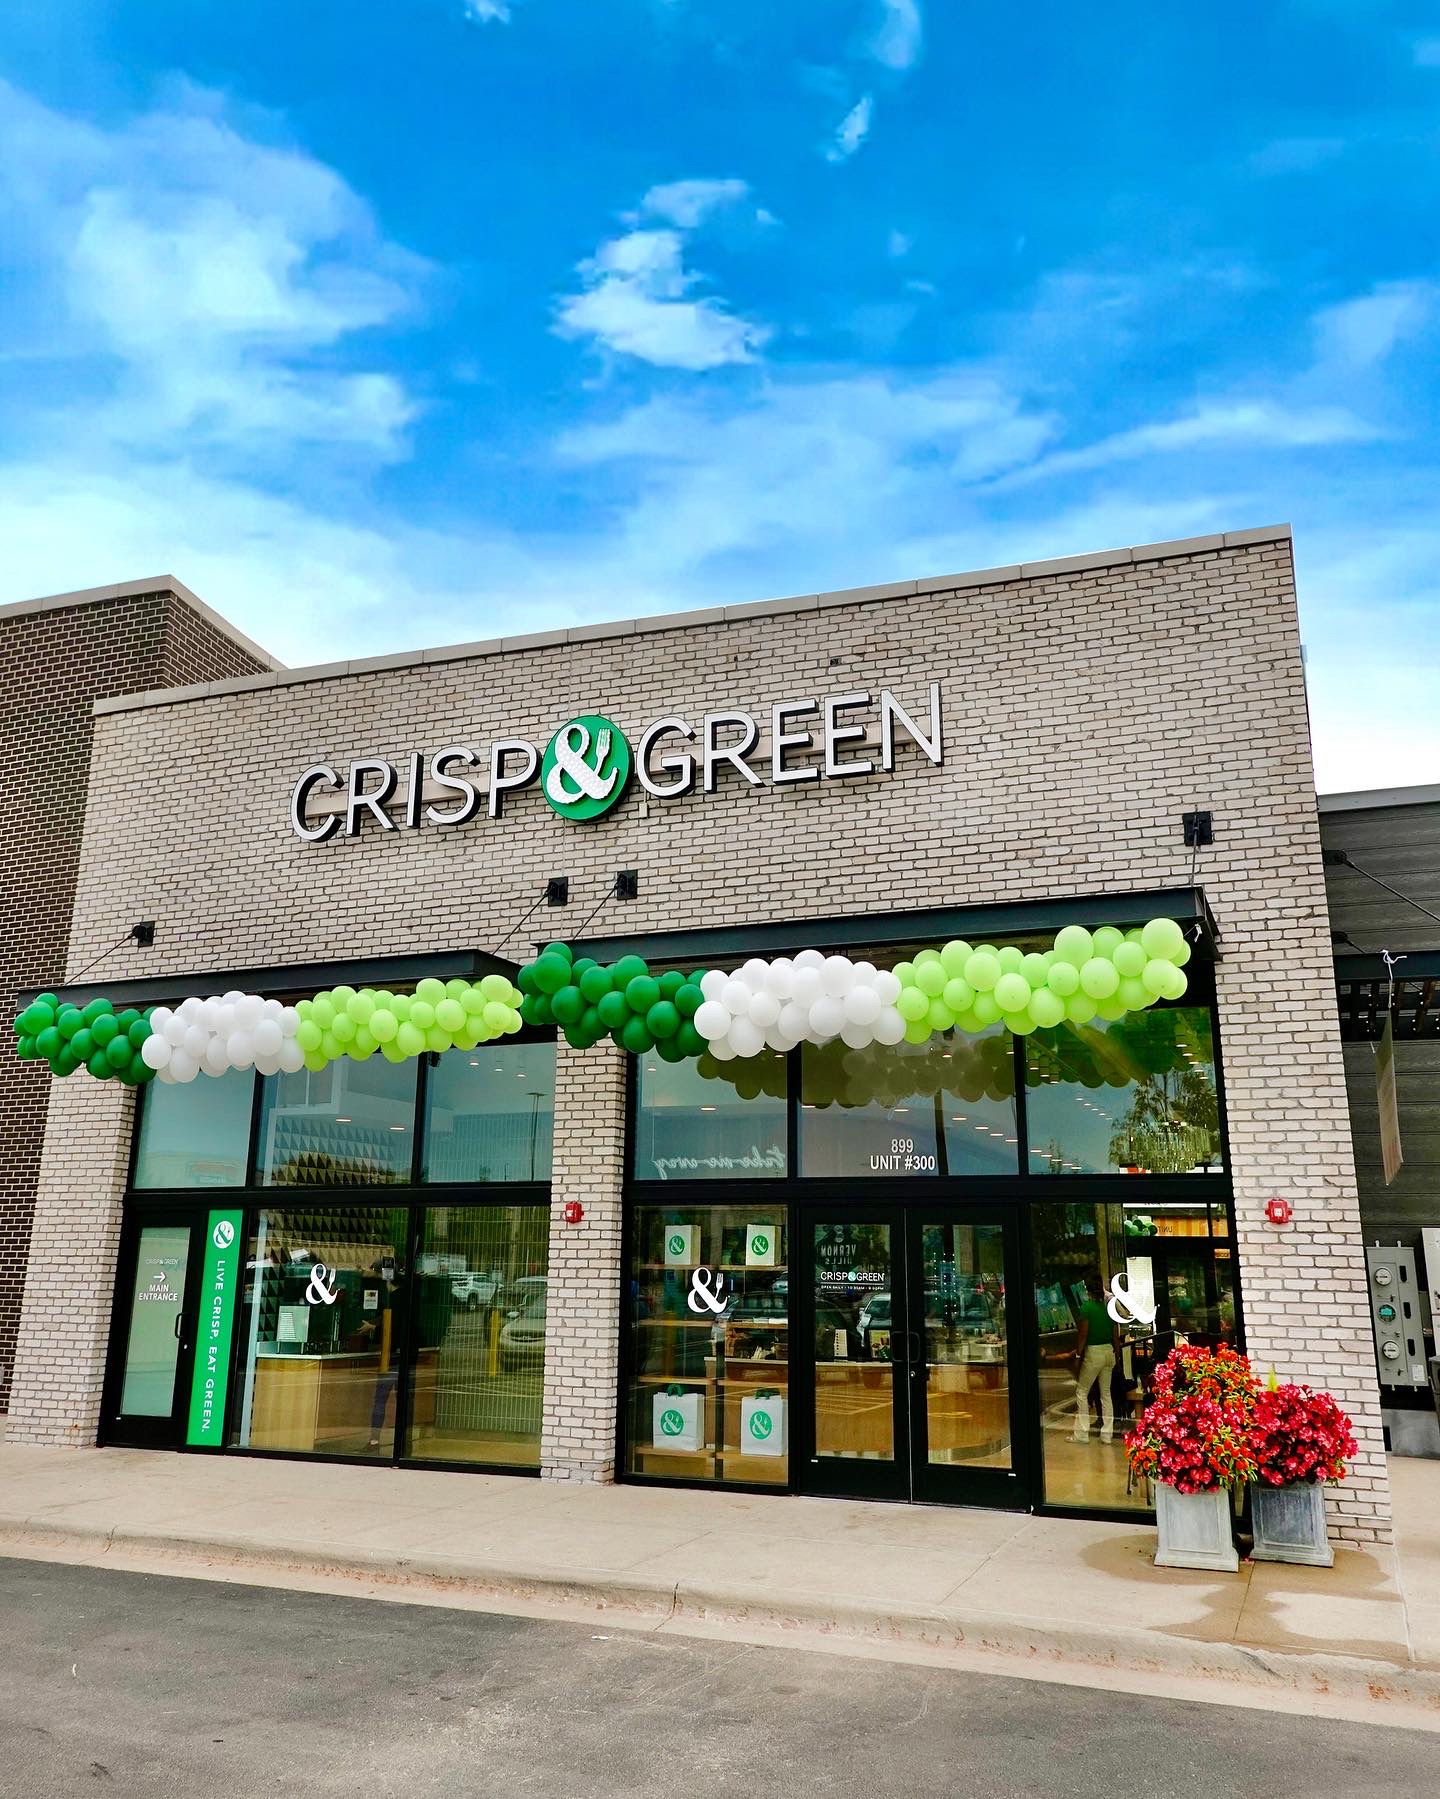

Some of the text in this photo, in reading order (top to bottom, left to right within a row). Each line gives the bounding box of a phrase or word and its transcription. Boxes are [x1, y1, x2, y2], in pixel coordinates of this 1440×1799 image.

[290, 740, 541, 842] CRISP
[637, 682, 941, 799] GREEN
[891, 1138, 913, 1153] 899
[870, 1155, 935, 1170] UNIT #300
[820, 1271, 848, 1281] CRISP
[857, 1272, 884, 1282] GREEN
[149, 1284, 169, 1292] MAIN
[138, 1292, 178, 1301] ENTRANCE
[201, 1260, 226, 1433] LIVE CRISP, EAT GREEN.
